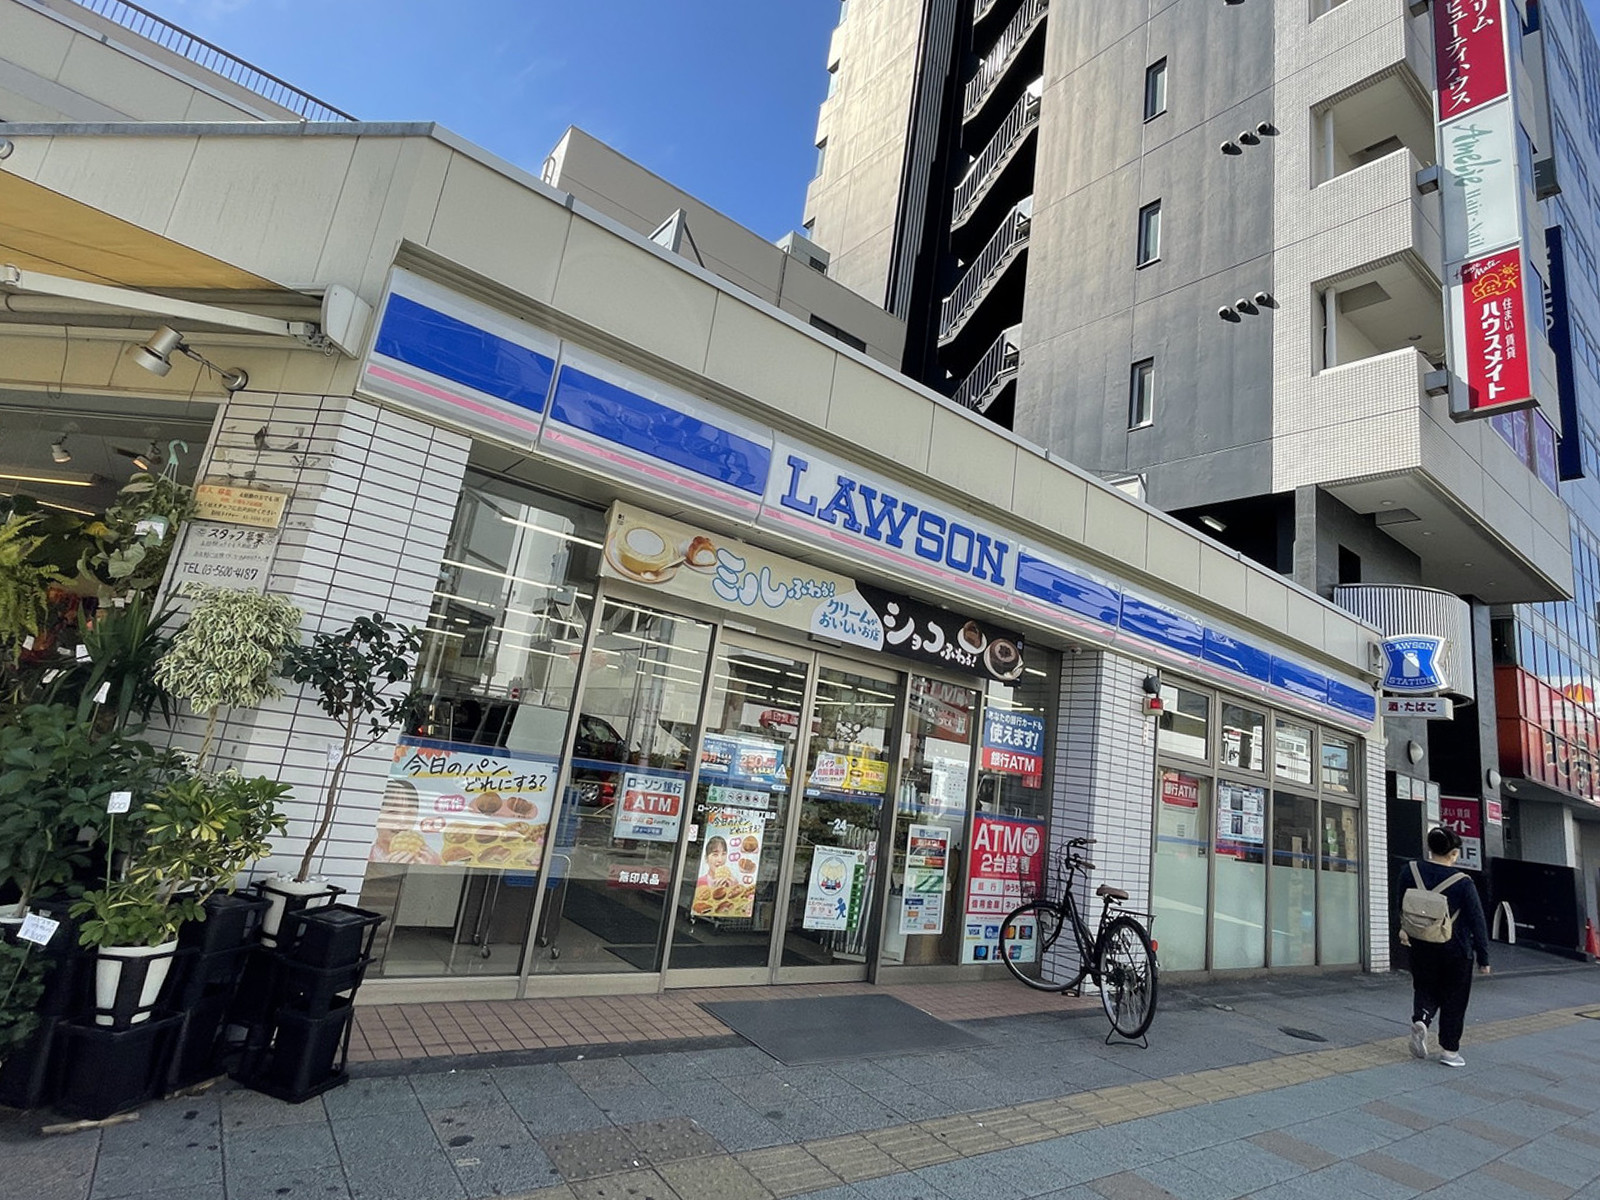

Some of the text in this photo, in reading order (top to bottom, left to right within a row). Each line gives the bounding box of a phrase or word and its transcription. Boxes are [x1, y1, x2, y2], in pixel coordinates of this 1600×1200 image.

[1480, 300, 1506, 400] ハウスメイト
[780, 454, 1010, 587] LAWSON
[182, 562, 201, 575] TEL
[818, 613, 882, 643] おいしいお店
[1386, 641, 1435, 653] LAWSON
[1388, 675, 1436, 686] STATION
[1387, 701, 1438, 713] 酒・たばこ
[989, 721, 1040, 752] 使えます!
[990, 750, 1036, 773] 銀行ATM
[626, 777, 682, 795] ローソン銀行
[631, 794, 672, 813] ATM
[974, 822, 1022, 854] ATM
[980, 852, 1031, 875] 2台設置
